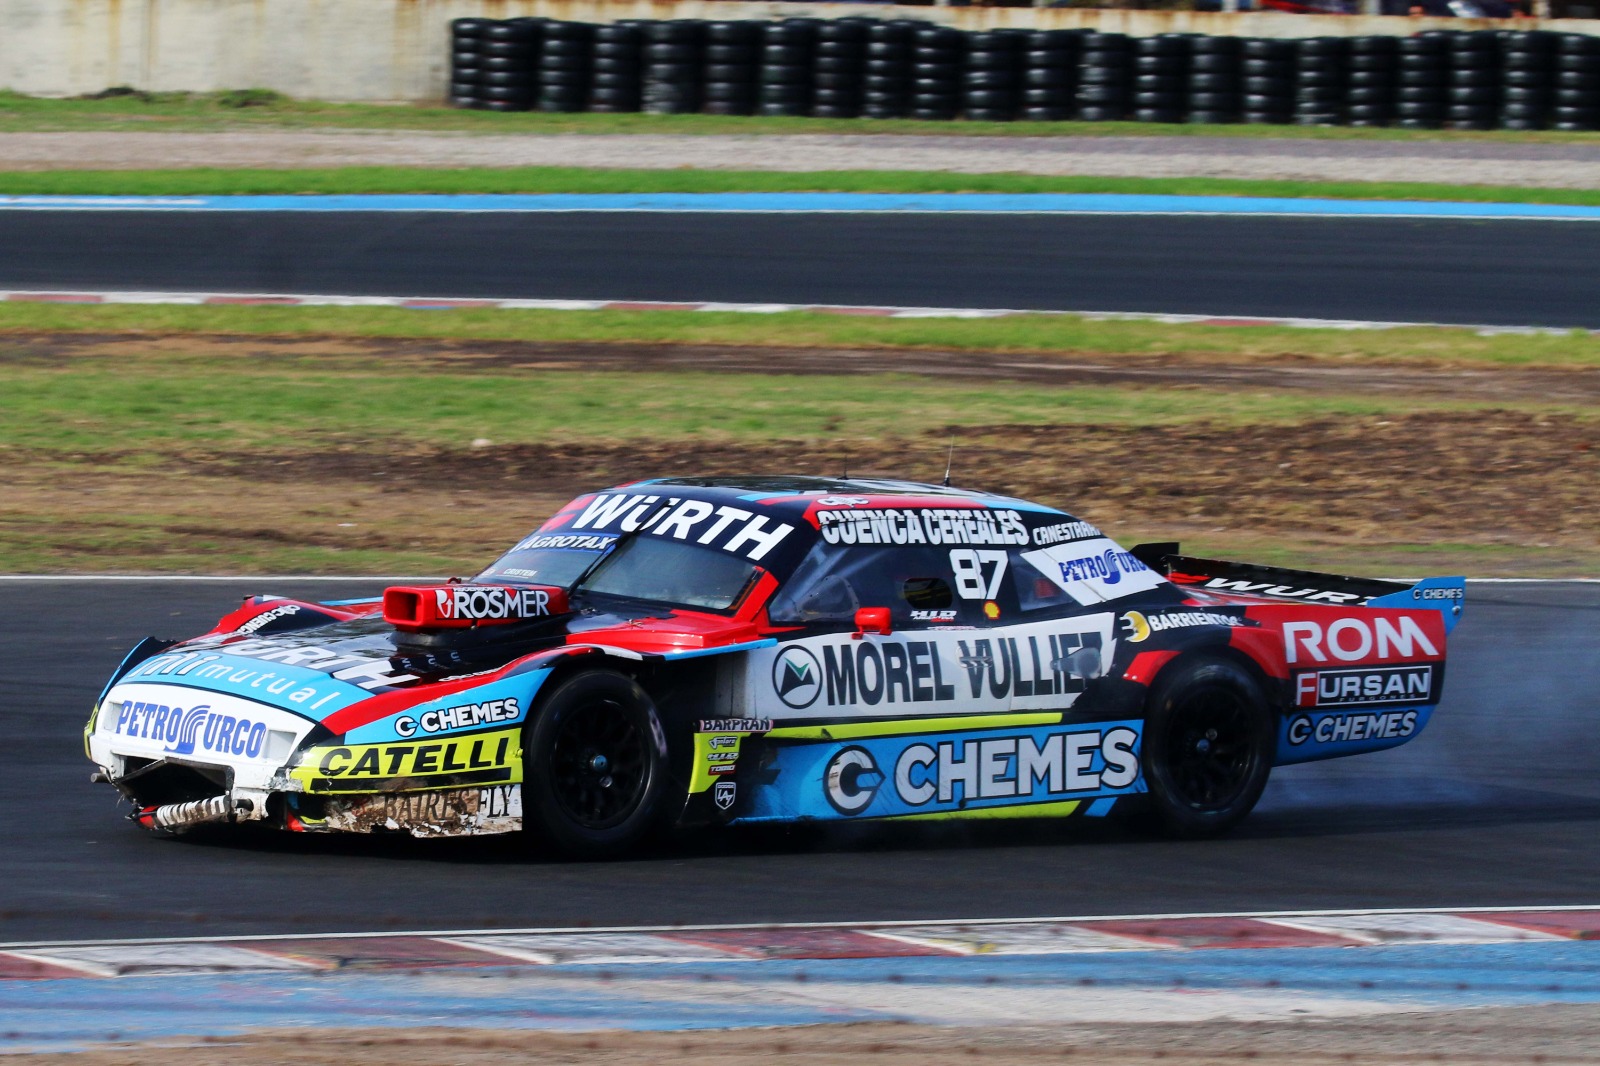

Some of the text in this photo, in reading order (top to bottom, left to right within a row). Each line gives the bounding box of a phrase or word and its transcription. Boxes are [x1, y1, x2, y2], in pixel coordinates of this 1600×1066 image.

[515, 536, 618, 550] AGROTAX
[572, 494, 795, 562] WÜRTH
[817, 508, 1029, 545] CUENCA CEREALES
[949, 549, 1008, 600] 87
[453, 590, 550, 619] ROSMER
[1422, 588, 1463, 600] CHEMES
[1283, 615, 1439, 664] ROM
[195, 663, 341, 711] mutual
[822, 641, 955, 707] MOREL
[1296, 672, 1430, 706] FURSAN
[1340, 693, 1416, 702] FURGONES
[420, 698, 519, 732] CHEMES
[703, 719, 770, 731] BARPRAN
[1315, 710, 1418, 743] CHEMES
[318, 737, 509, 777] CATELLI
[894, 728, 1139, 805] CHEMES
[476, 784, 515, 818] FLY
